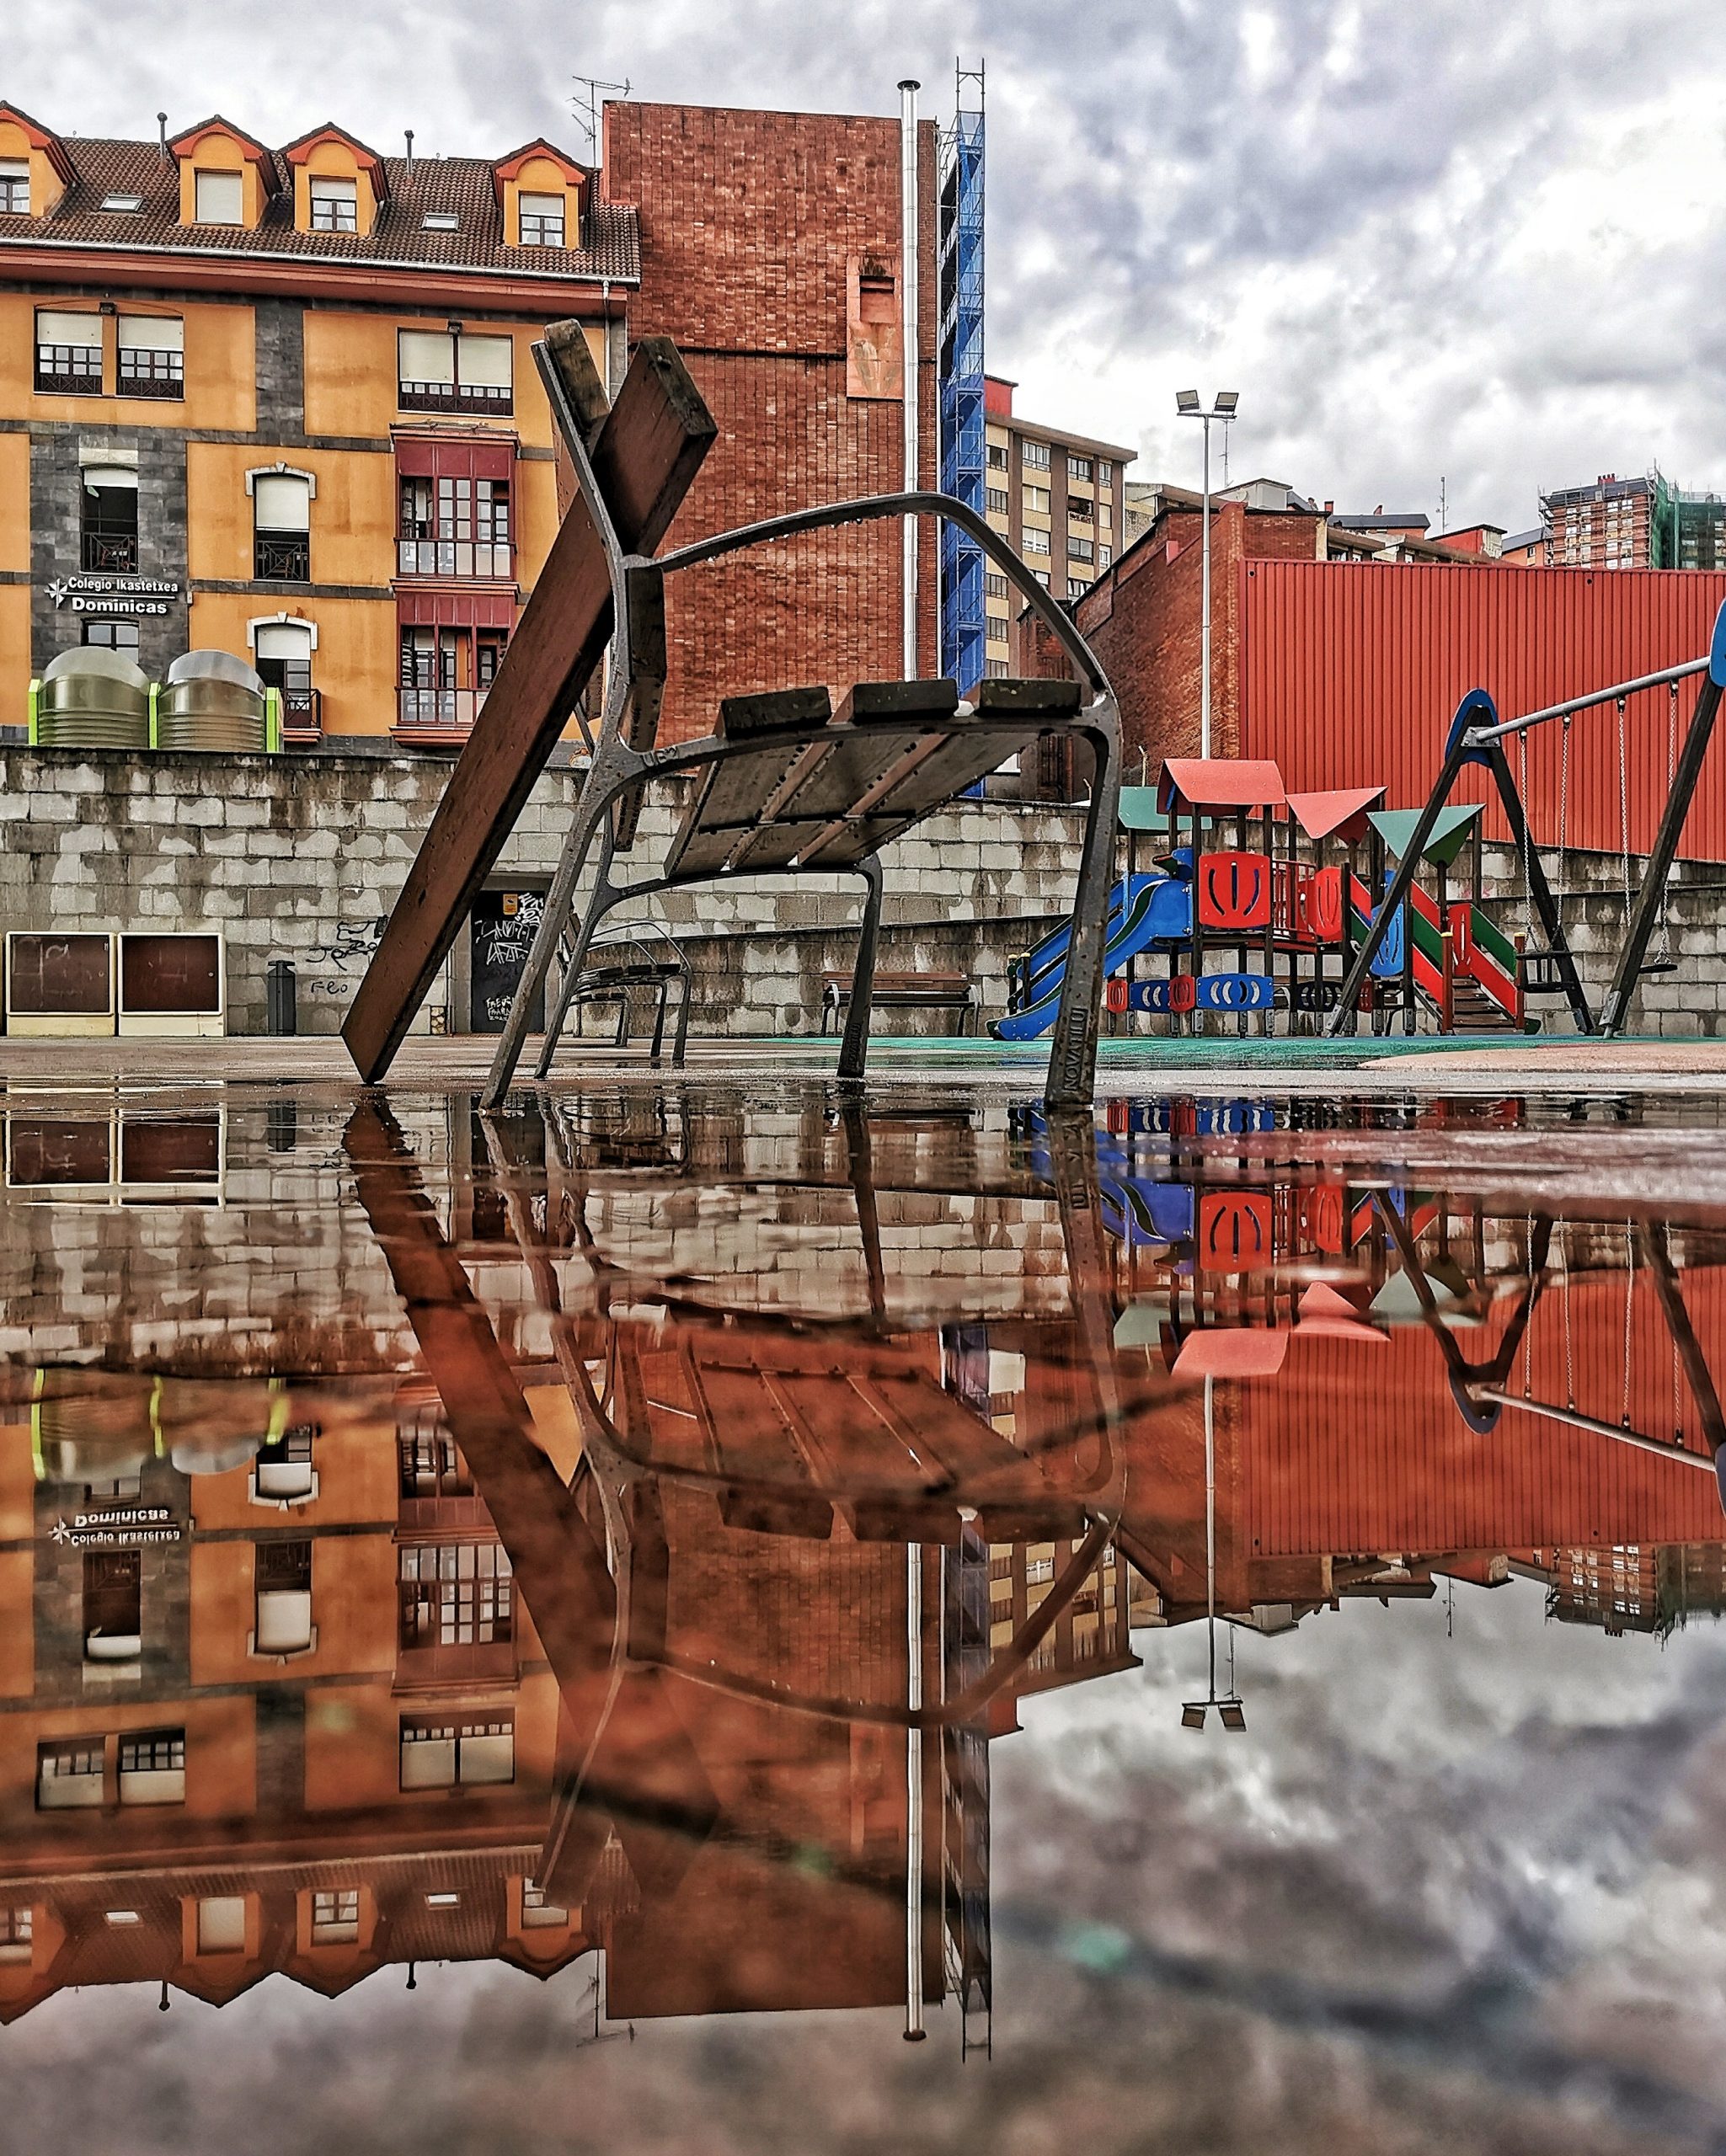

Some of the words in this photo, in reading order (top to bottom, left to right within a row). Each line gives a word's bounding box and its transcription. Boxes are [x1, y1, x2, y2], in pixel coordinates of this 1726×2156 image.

[68, 576, 112, 591] Colegio
[116, 579, 179, 593] Ikastetxea
[72, 596, 167, 614] Dominicas
[1064, 1007, 1087, 1091] NOVATILU
